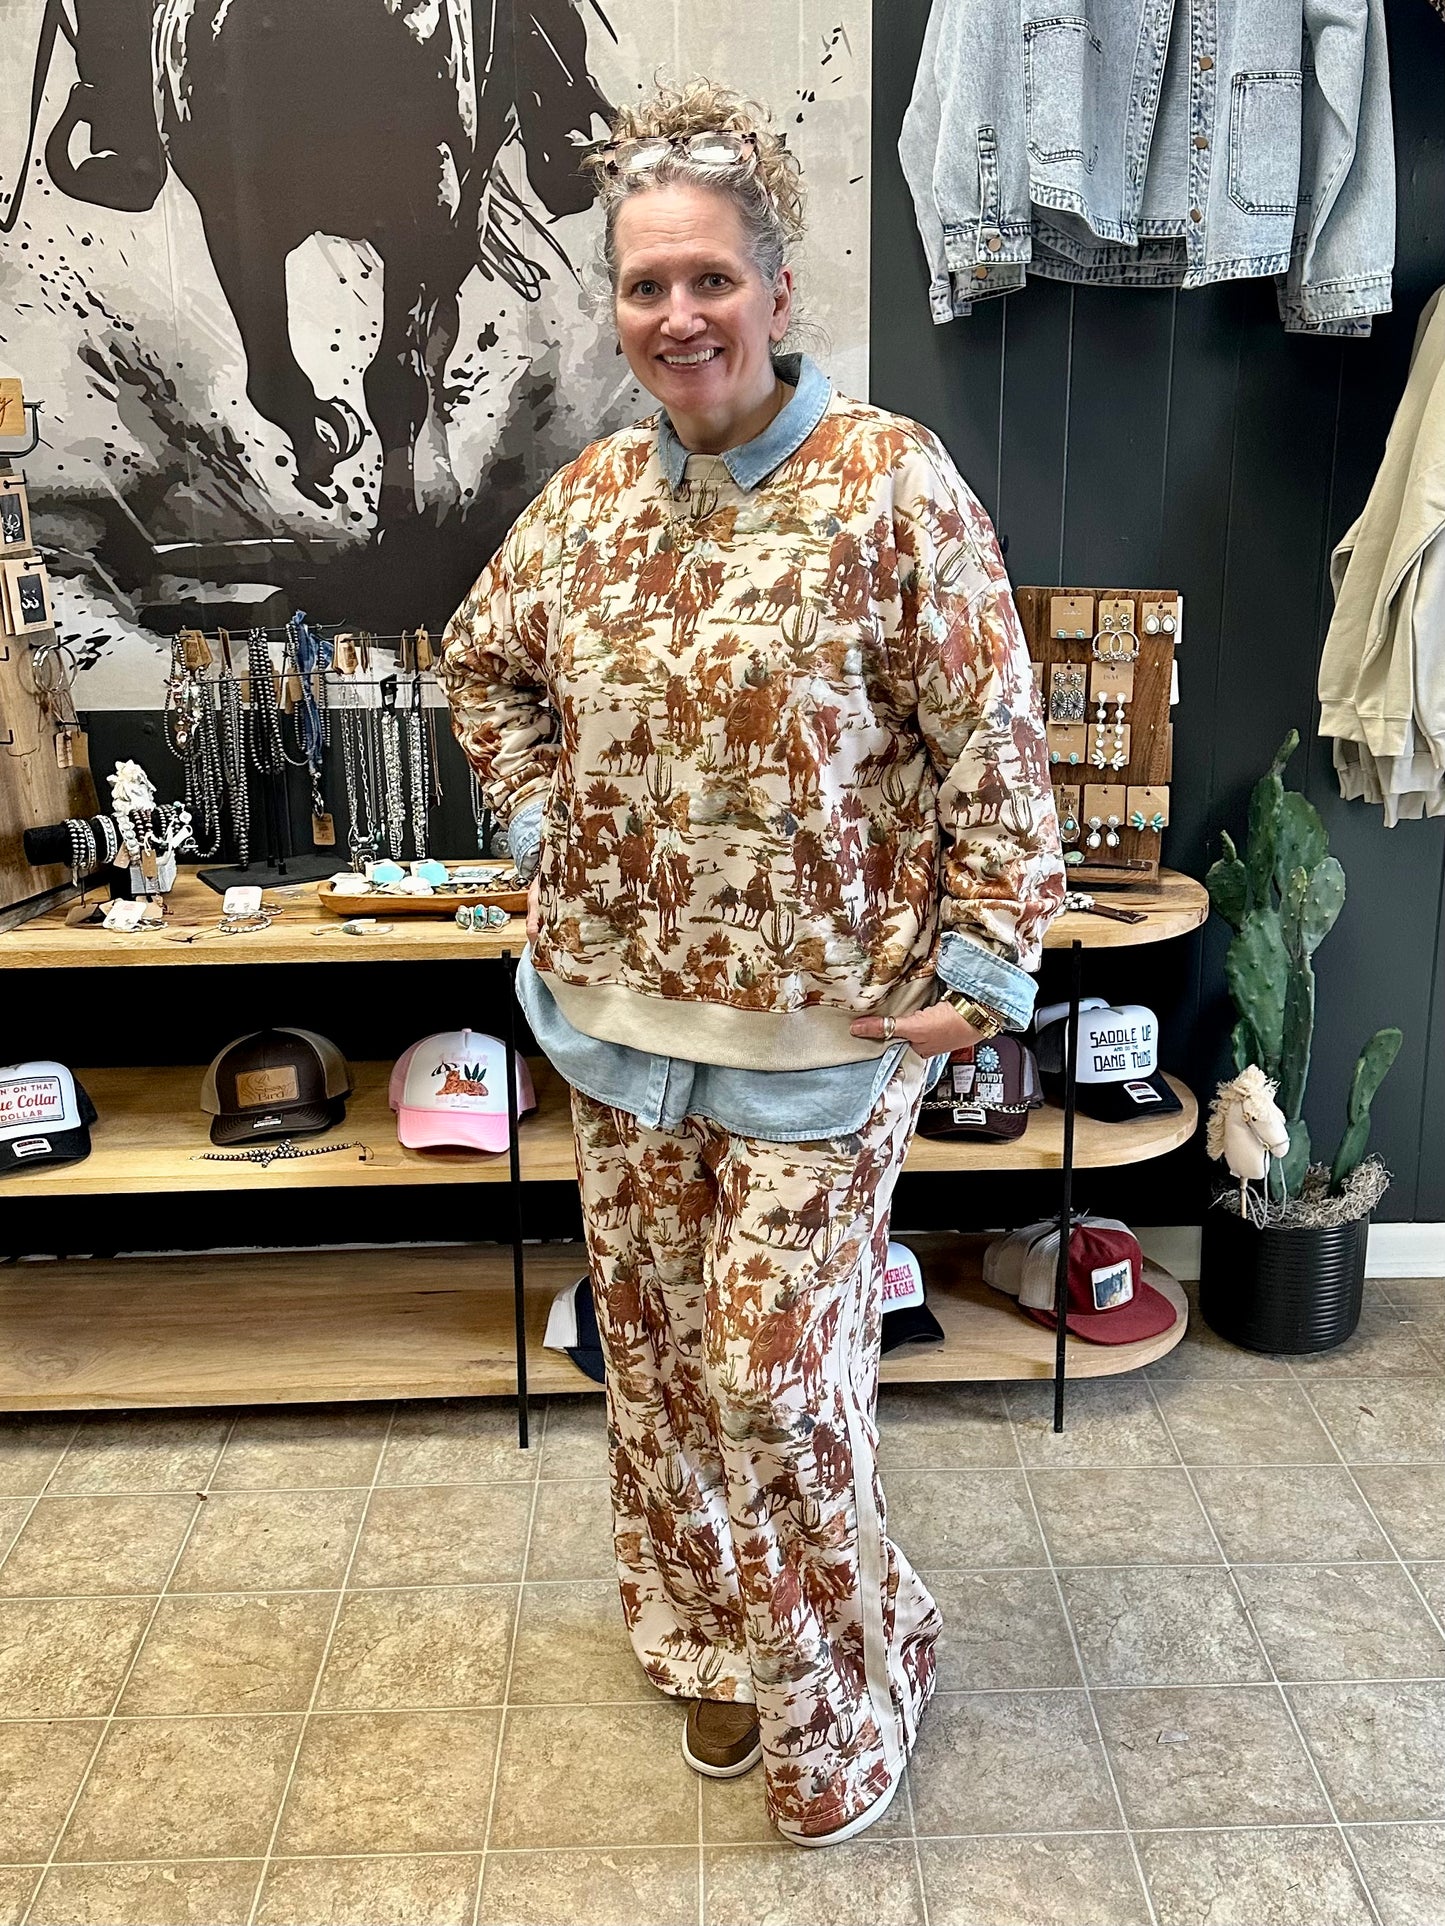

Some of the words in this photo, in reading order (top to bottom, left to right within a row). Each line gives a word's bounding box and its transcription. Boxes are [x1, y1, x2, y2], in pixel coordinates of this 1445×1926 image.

[1089, 1027, 1138, 1049] SADDLE
[1093, 1053, 1127, 1073] DANG
[975, 1072, 1004, 1084] HOWDY
[17, 1093, 58, 1109] Collar
[0, 1110, 43, 1121] DOLLAR
